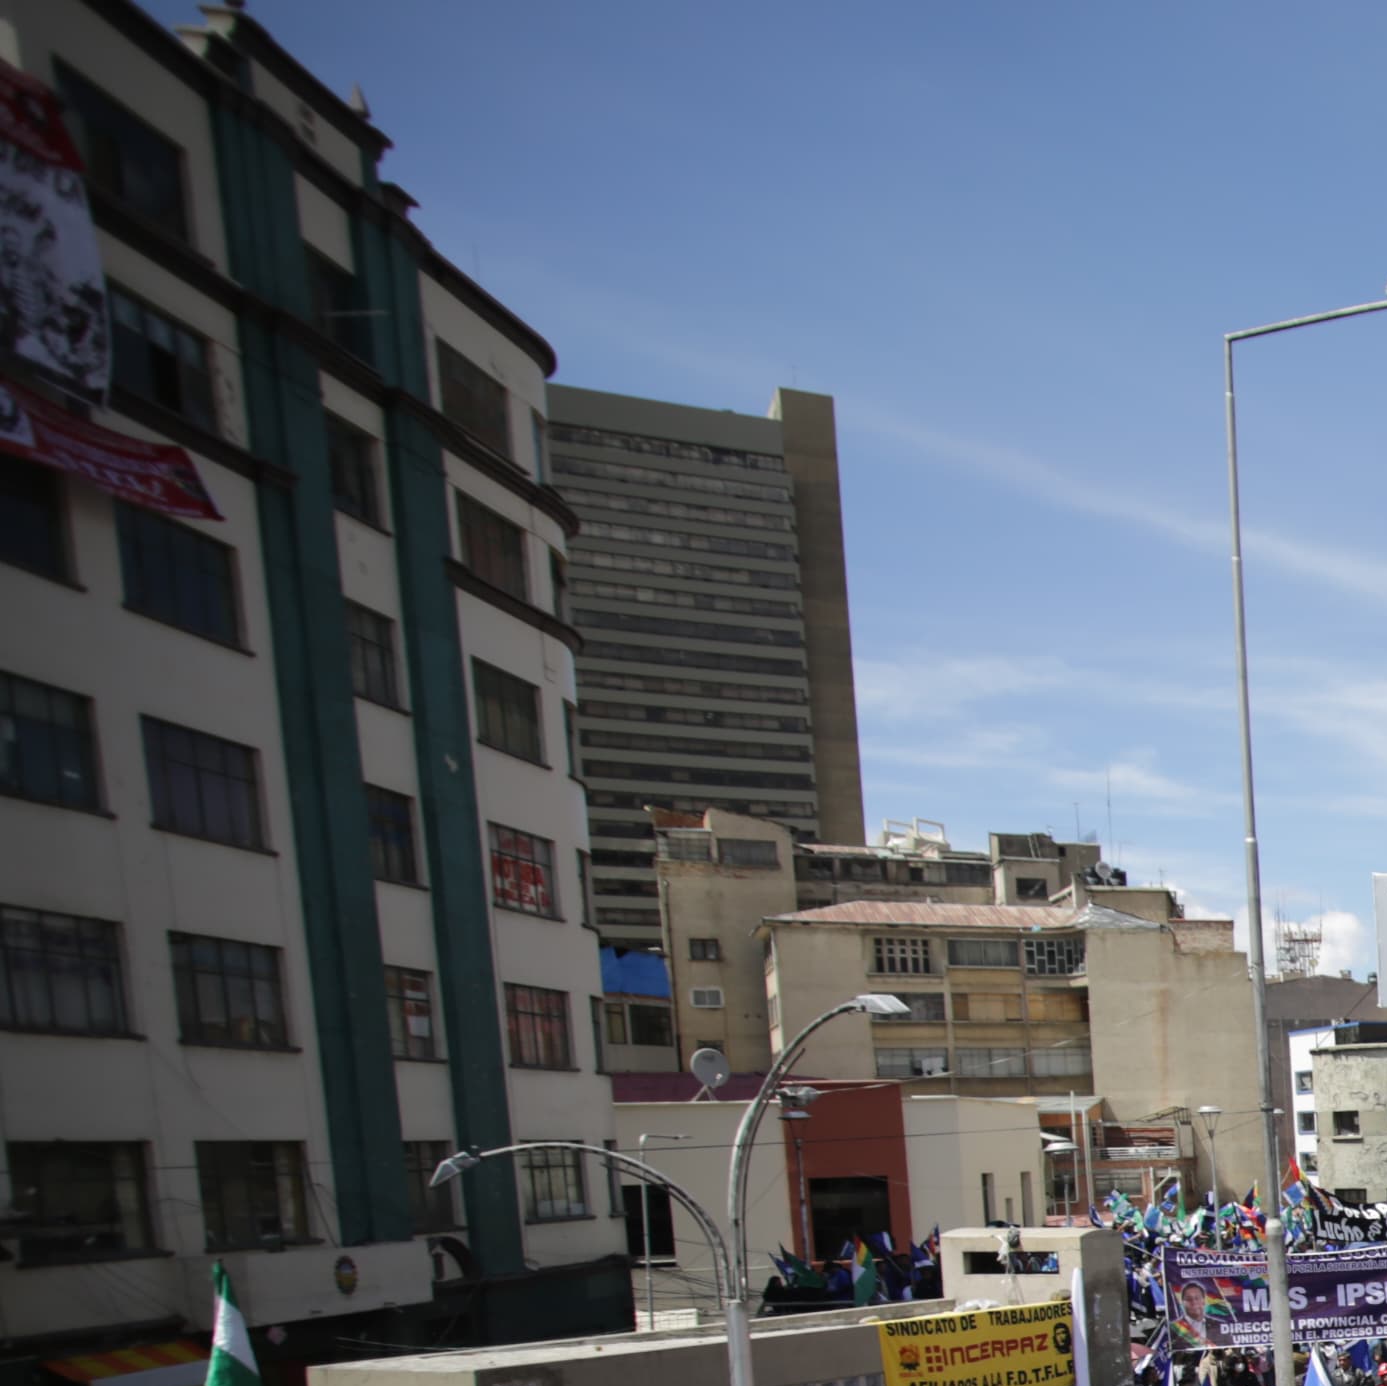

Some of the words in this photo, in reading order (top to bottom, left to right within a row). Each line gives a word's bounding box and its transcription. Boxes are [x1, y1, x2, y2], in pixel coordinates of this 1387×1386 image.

[1314, 1209, 1364, 1241] Lucho
[1367, 1221, 1384, 1241] por
[1181, 1265, 1248, 1279] INSTRUMENTO
[1293, 1264, 1314, 1274] POR
[1314, 1263, 1327, 1273] LA
[1242, 1286, 1308, 1313] MS
[887, 1319, 957, 1337] SINDICATO
[960, 1314, 977, 1331] DE
[988, 1302, 1073, 1327] TRABAJADORES
[1298, 1314, 1377, 1330] PROVINCIAL
[1322, 1327, 1374, 1339] PROCESO
